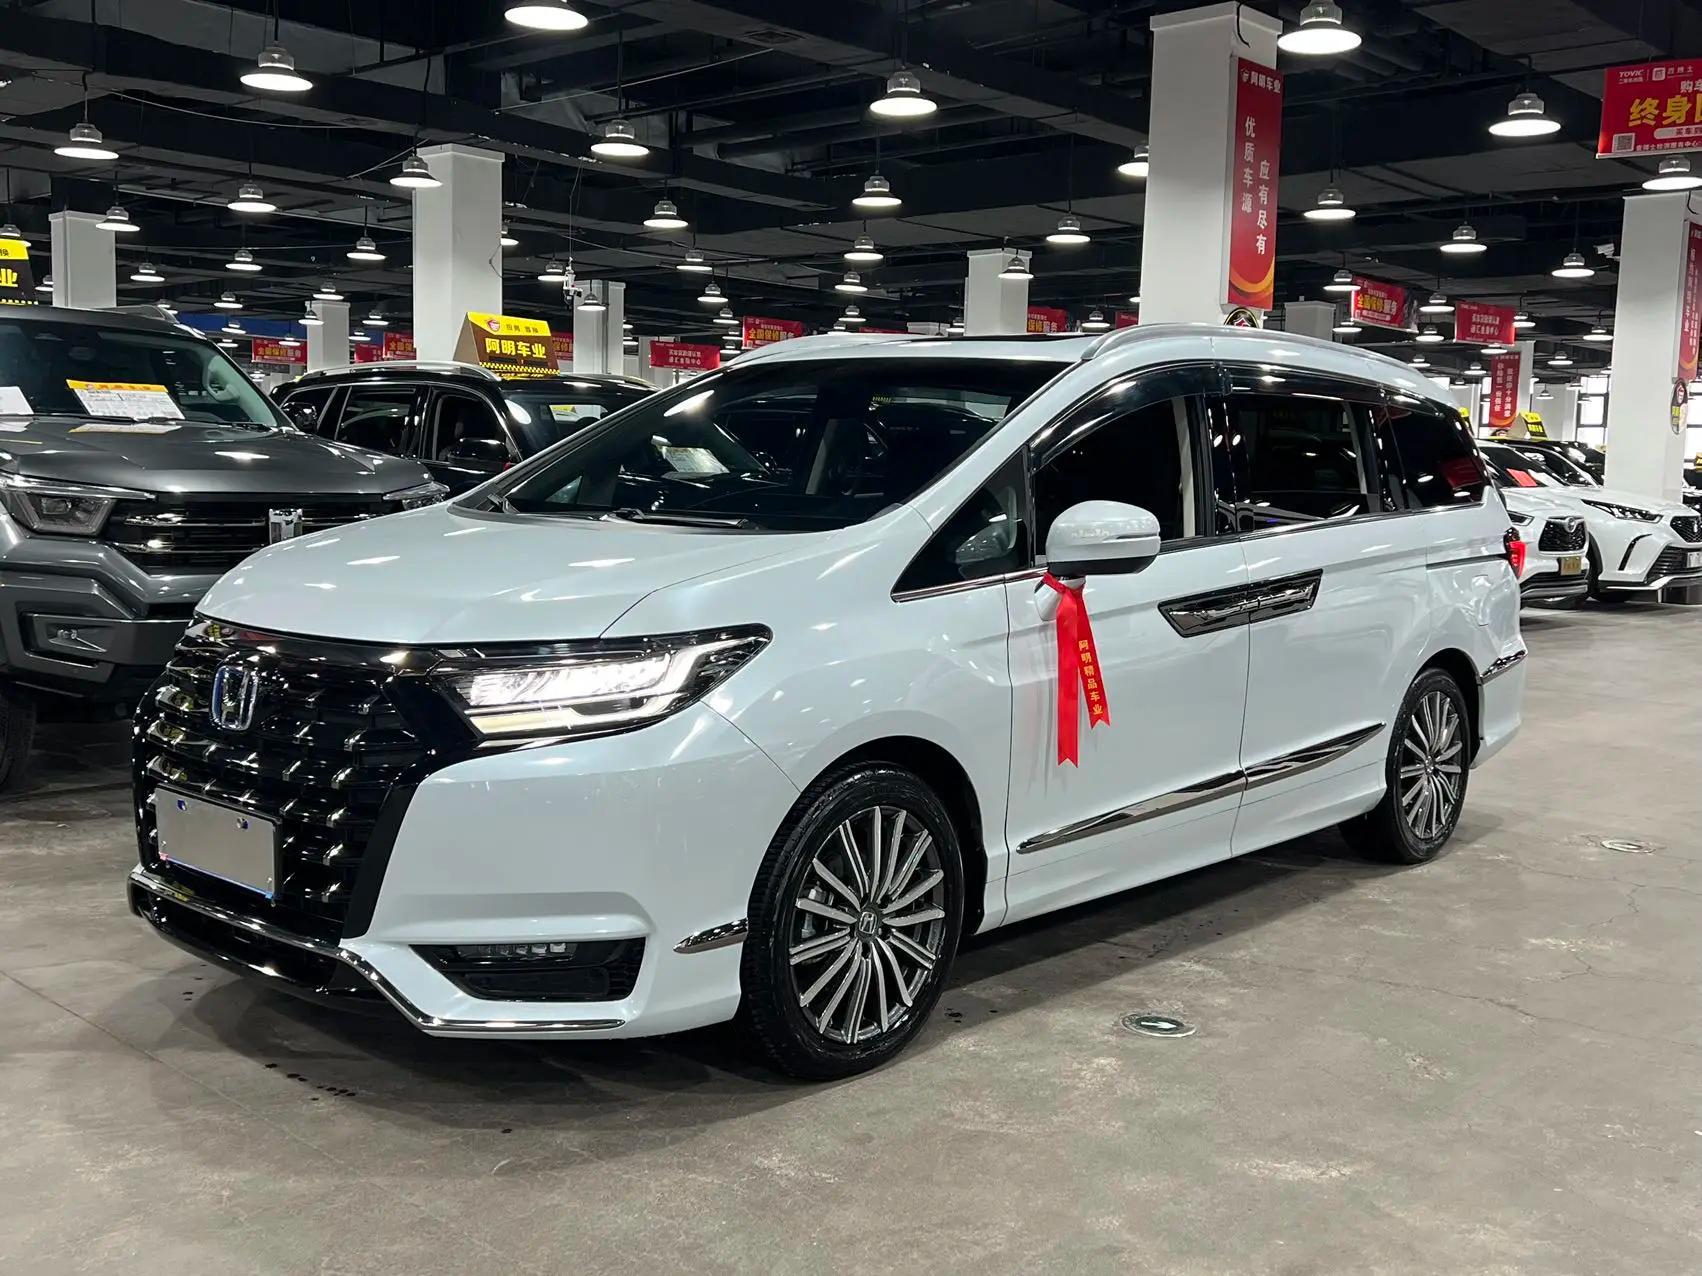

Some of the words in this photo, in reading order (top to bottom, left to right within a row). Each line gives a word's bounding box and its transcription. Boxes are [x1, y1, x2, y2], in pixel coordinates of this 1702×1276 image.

[1250, 71, 1281, 93] 阿明车业
[1628, 93, 1702, 127] 终身
[1242, 116, 1256, 214] 优质车源
[1256, 160, 1270, 255] 应有尽有
[485, 337, 547, 359] 阿明车业
[1078, 639, 1104, 716] 阿明精品车业
